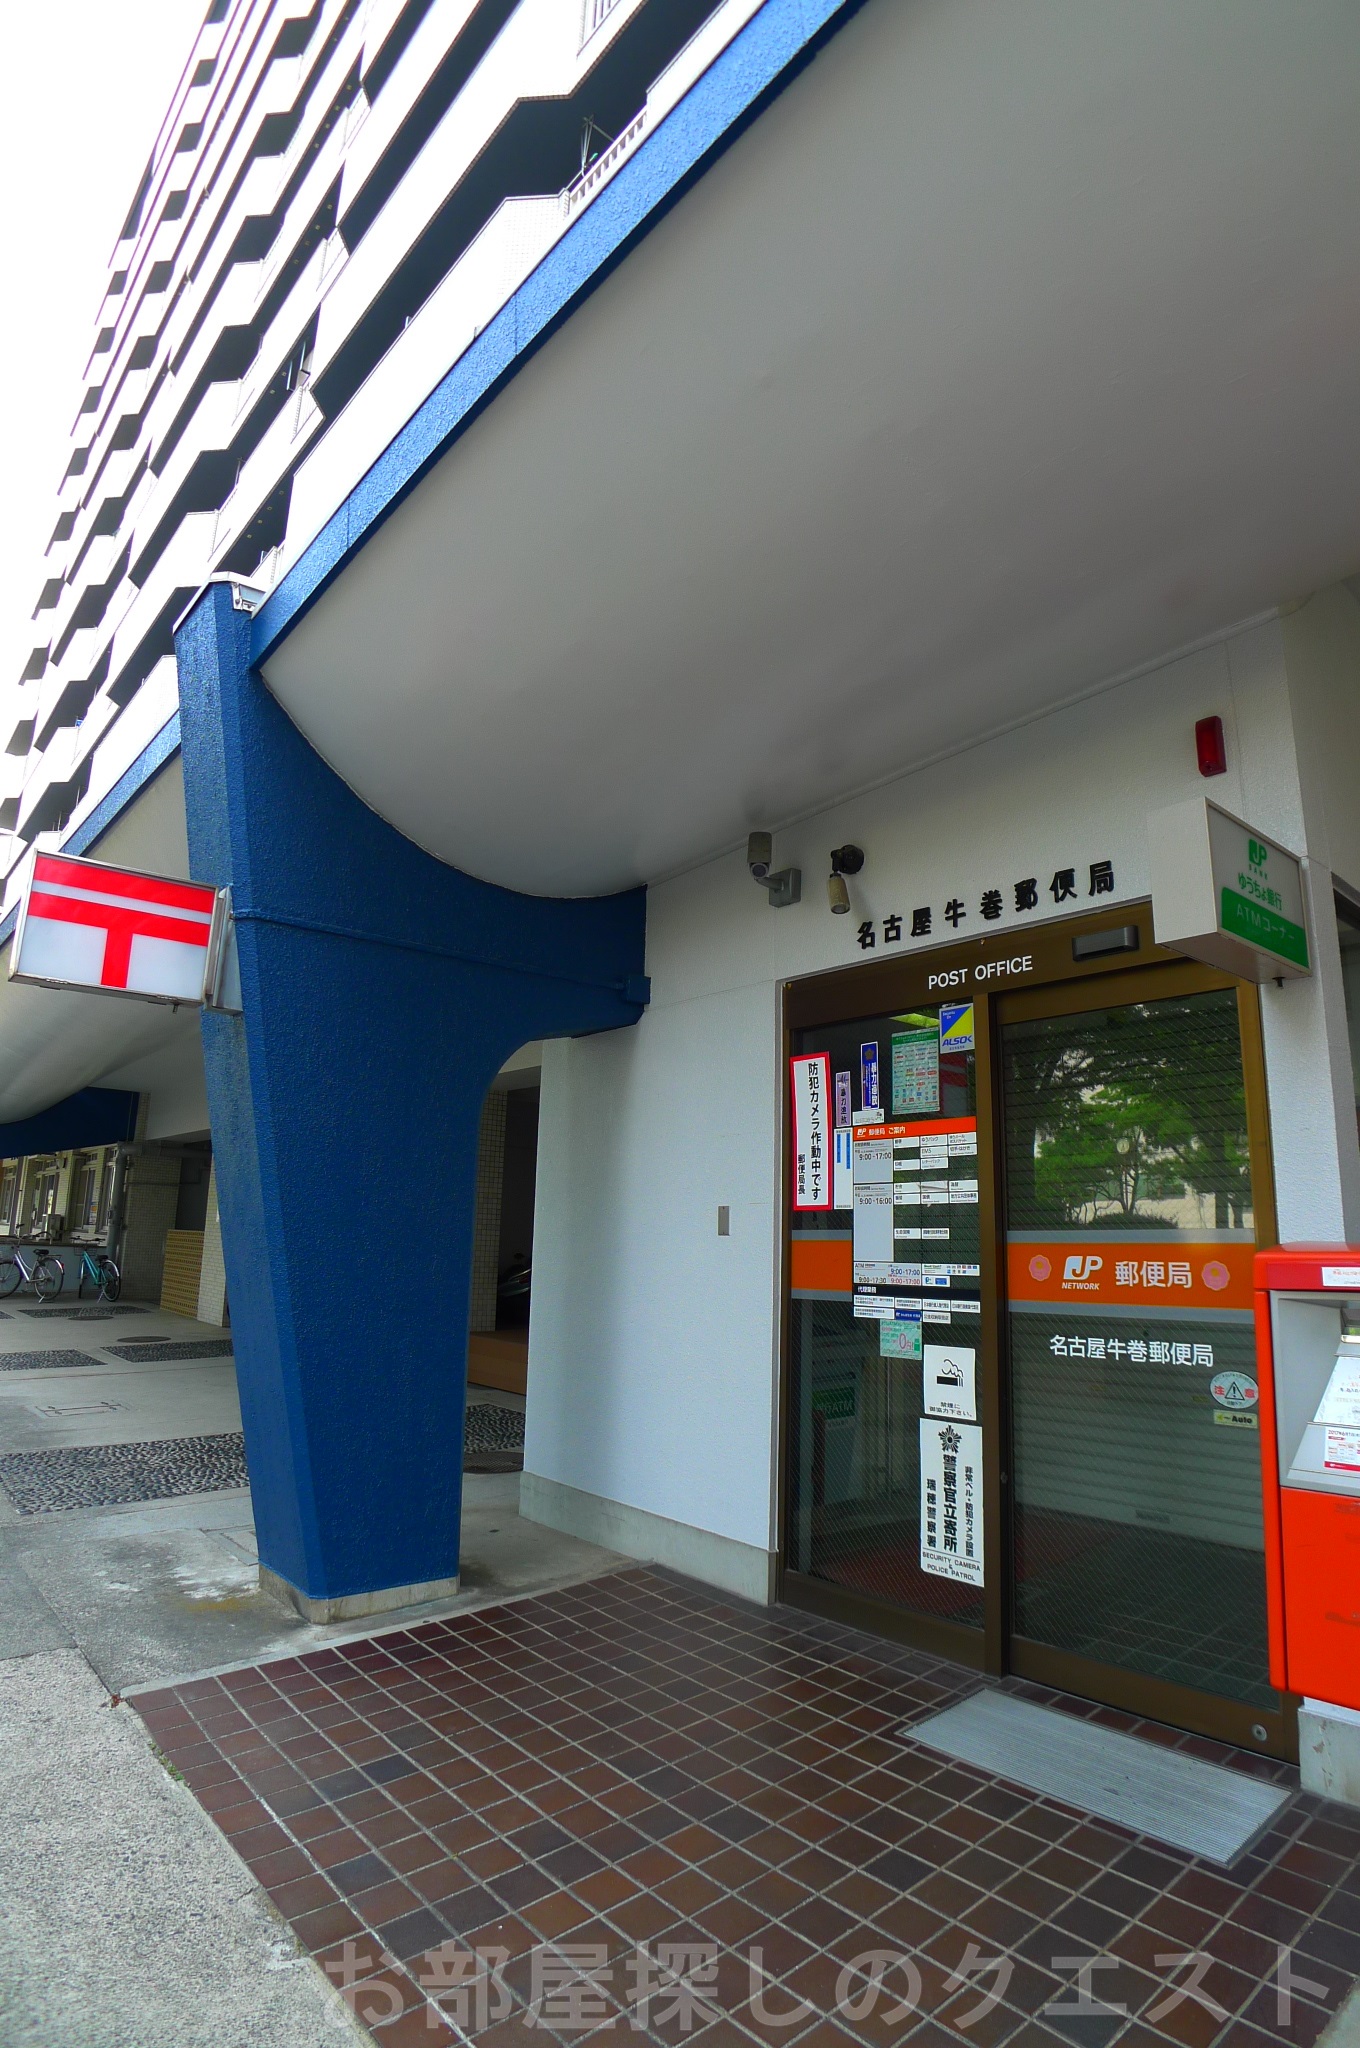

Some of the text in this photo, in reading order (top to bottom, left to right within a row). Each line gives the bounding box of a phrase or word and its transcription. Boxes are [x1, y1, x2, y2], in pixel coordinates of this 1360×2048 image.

[857, 860, 1115, 949] 名古屋牛巻郵便局
[1238, 872, 1282, 911] ゆうちょ銀行
[1236, 903, 1295, 939] ATMコーナー
[928, 955, 1033, 990] POST OFFICE
[942, 1036, 973, 1047] ALSOK
[808, 1062, 822, 1200] 防犯カメラ作動中です
[797, 1154, 806, 1195] 郵便局長
[1063, 1255, 1103, 1280] JP
[1115, 1261, 1193, 1289] 郵便局
[1061, 1281, 1100, 1291] NETWORK
[1050, 1334, 1214, 1367] 名古屋牛巻郵便局
[1232, 1415, 1253, 1424] Auto
[926, 1478, 936, 1548] 瑞穂警察署
[943, 1454, 958, 1553] 警察官立寄所
[922, 1551, 981, 1571] SECURITY CAMERA
[927, 1563, 976, 1581] POLICE PATROL
